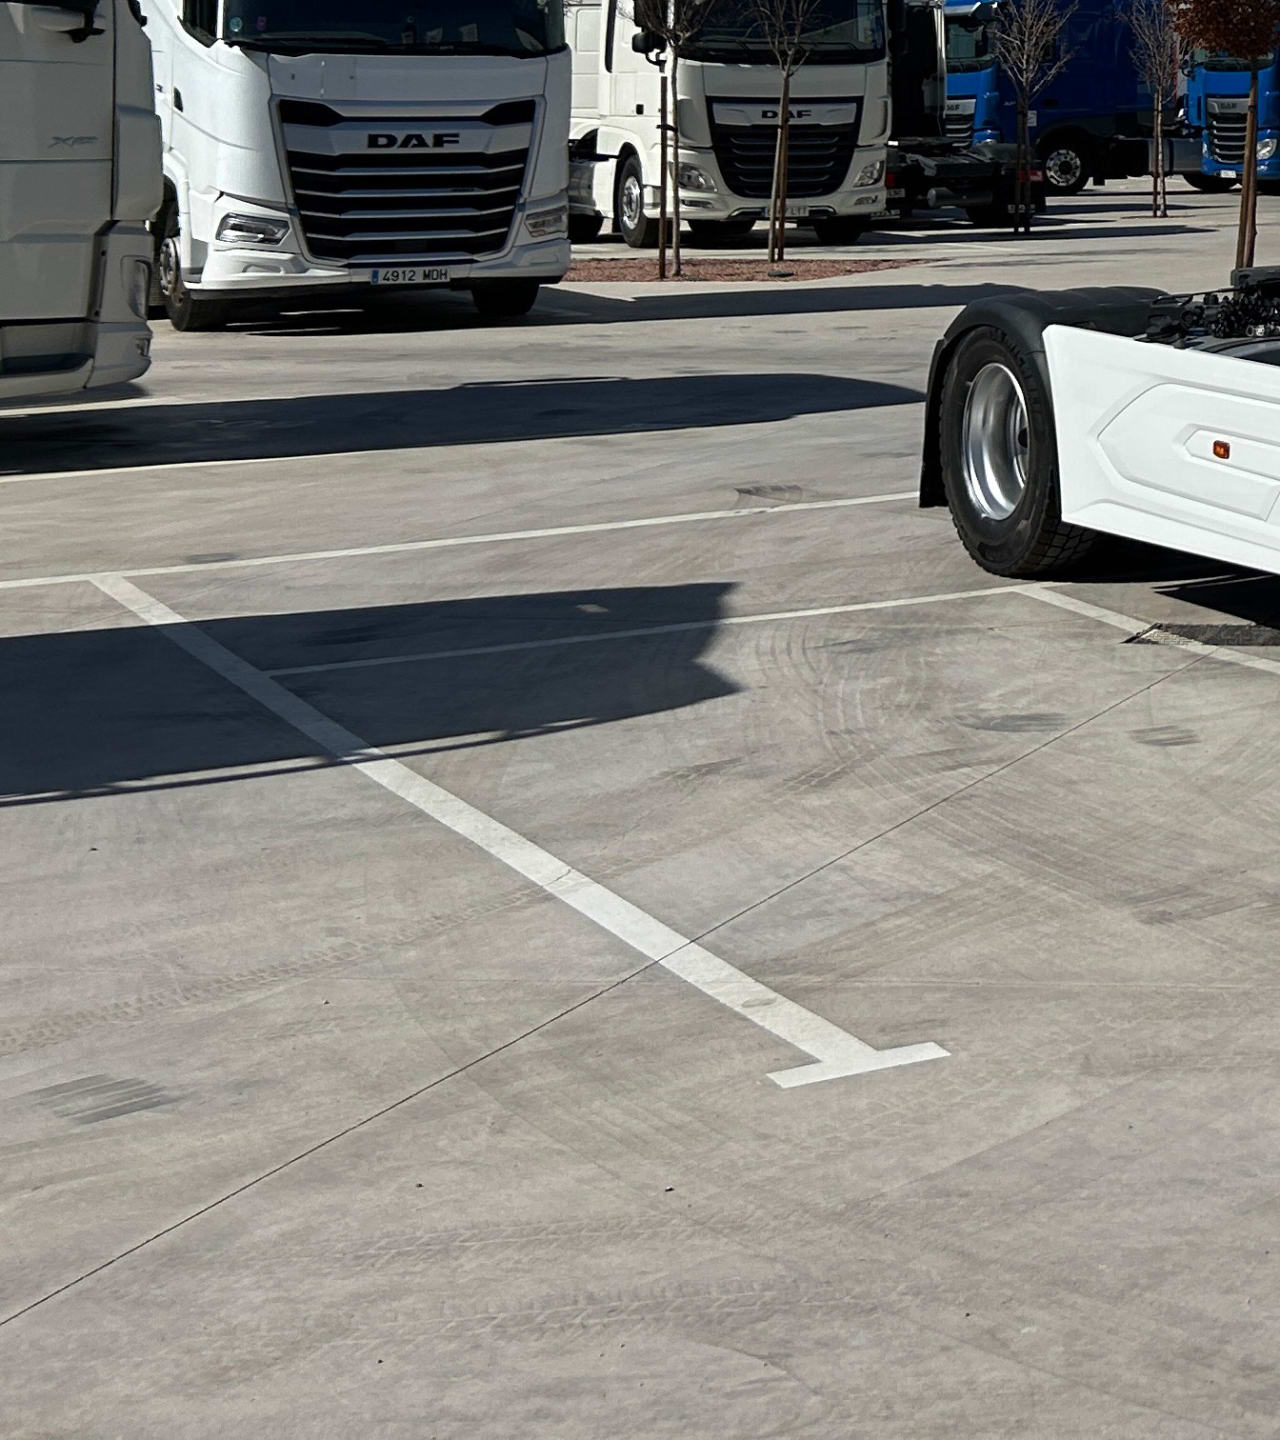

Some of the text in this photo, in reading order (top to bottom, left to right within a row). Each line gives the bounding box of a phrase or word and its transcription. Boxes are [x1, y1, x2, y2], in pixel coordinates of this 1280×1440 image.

[367, 133, 460, 149] DAF
[382, 268, 448, 282] 4912 MDH
